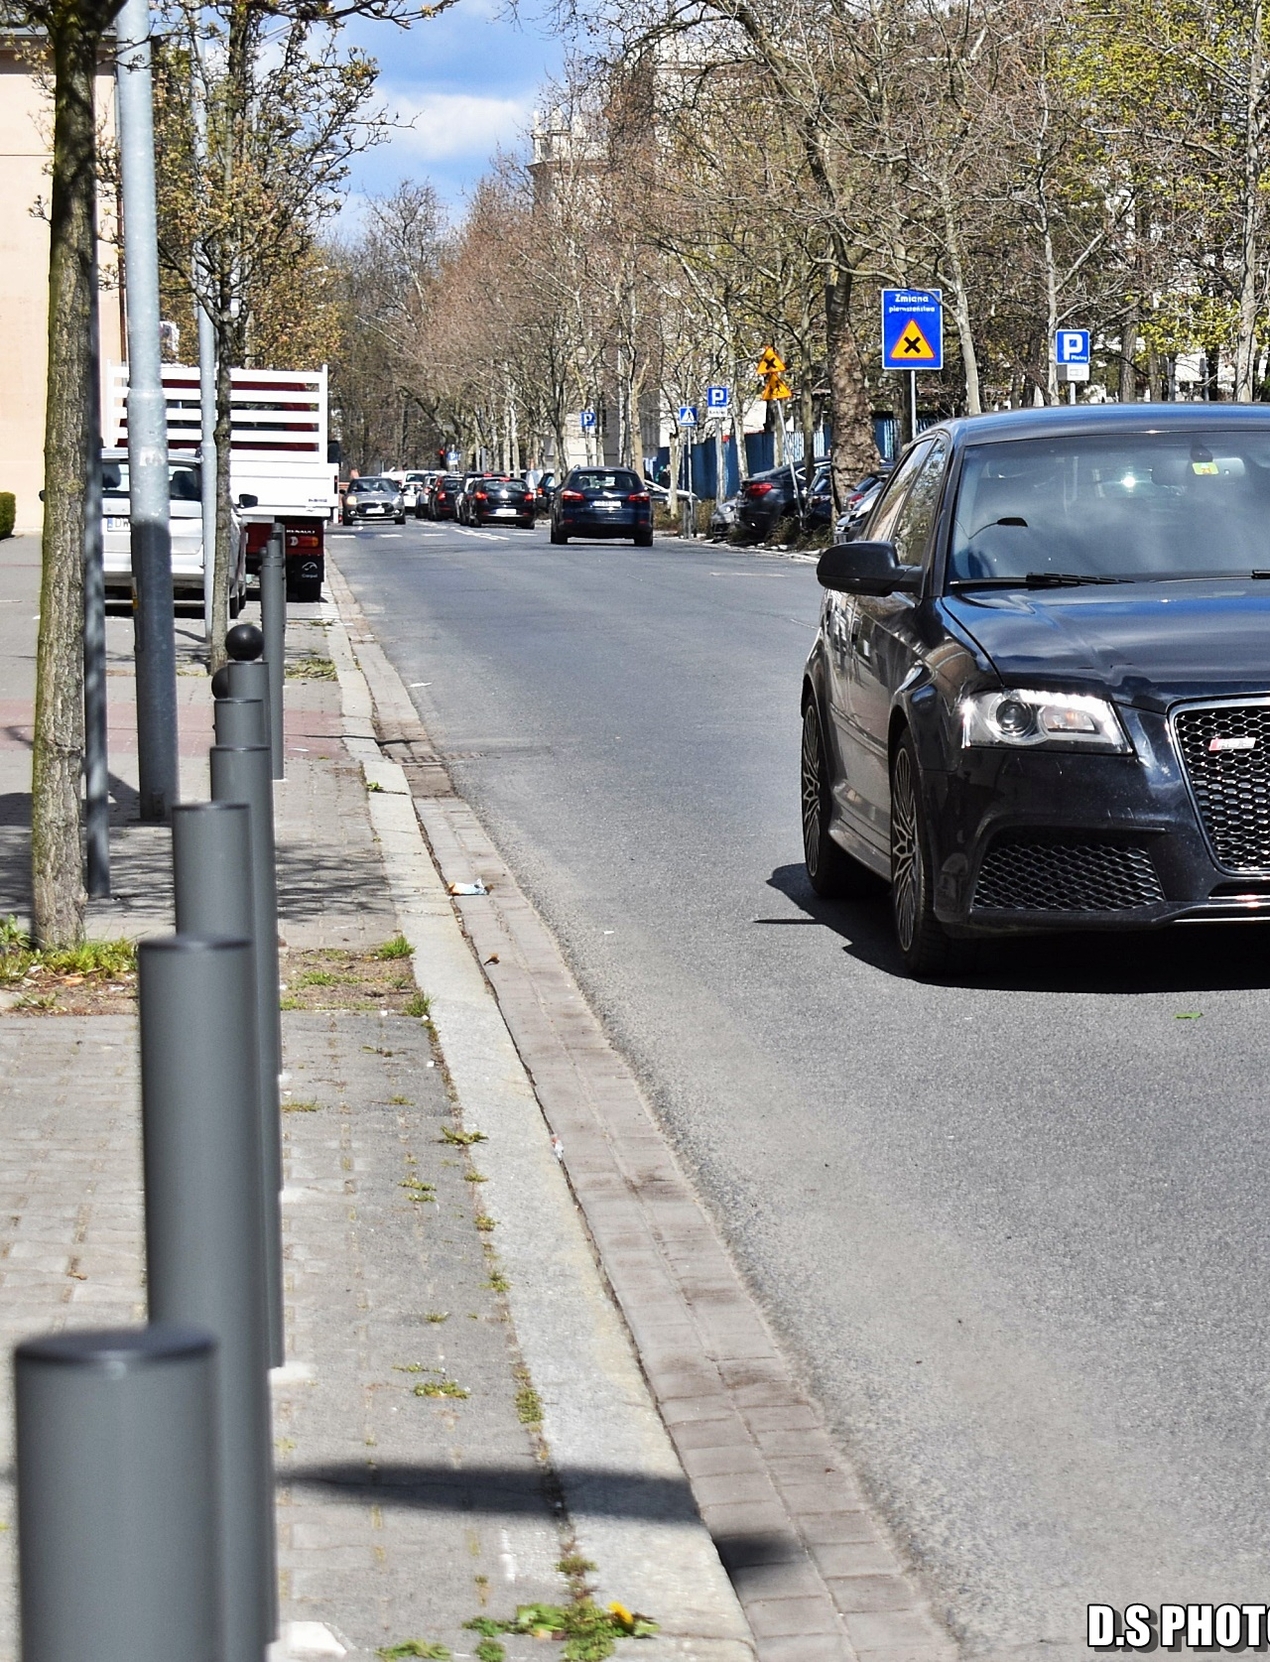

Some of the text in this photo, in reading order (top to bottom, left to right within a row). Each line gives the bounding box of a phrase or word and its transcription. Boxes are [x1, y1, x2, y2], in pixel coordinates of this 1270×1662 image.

[894, 293, 929, 303] Zmiana
[1063, 333, 1083, 361] P
[711, 389, 725, 406] P
[583, 413, 594, 425] P
